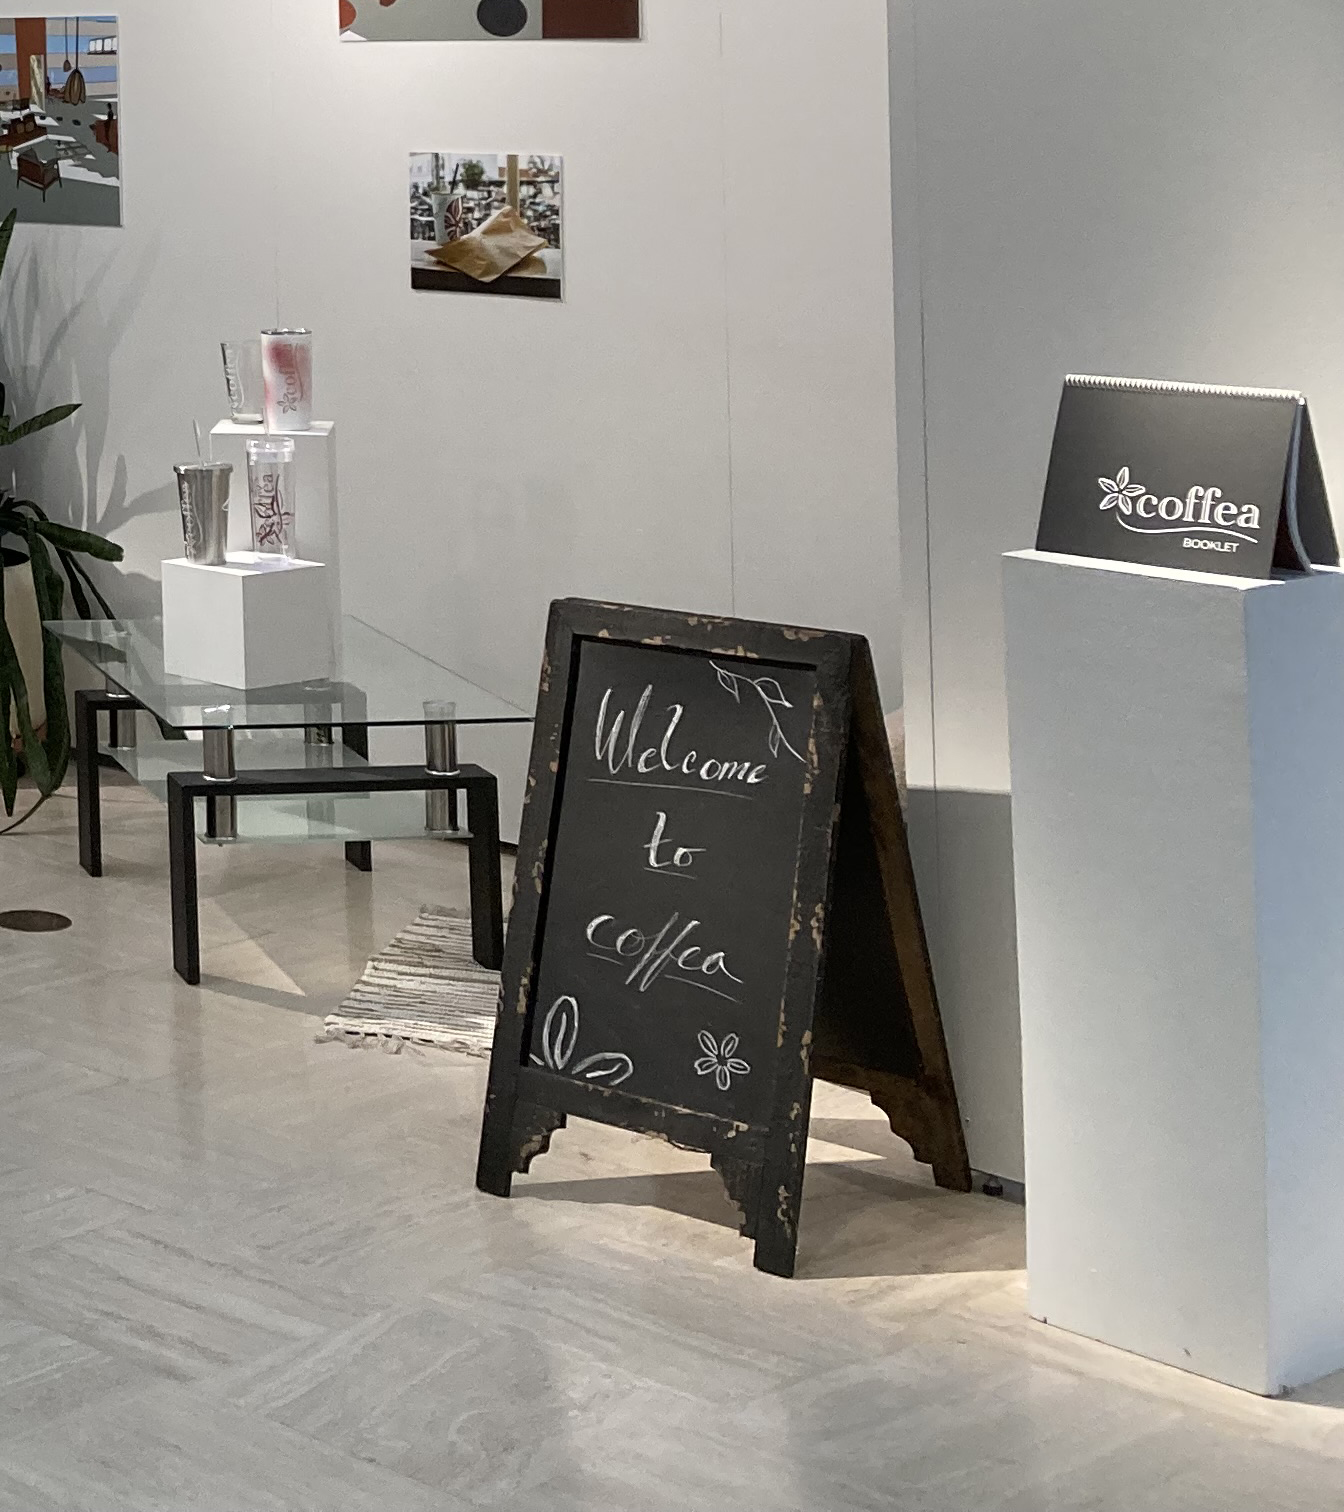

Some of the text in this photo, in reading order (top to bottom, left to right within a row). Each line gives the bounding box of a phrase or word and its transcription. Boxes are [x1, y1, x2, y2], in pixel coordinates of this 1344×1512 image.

[1136, 486, 1261, 529] coffea
[1183, 538, 1240, 553] BOOKLET
[595, 684, 768, 784] Welcome
[642, 811, 707, 868] to
